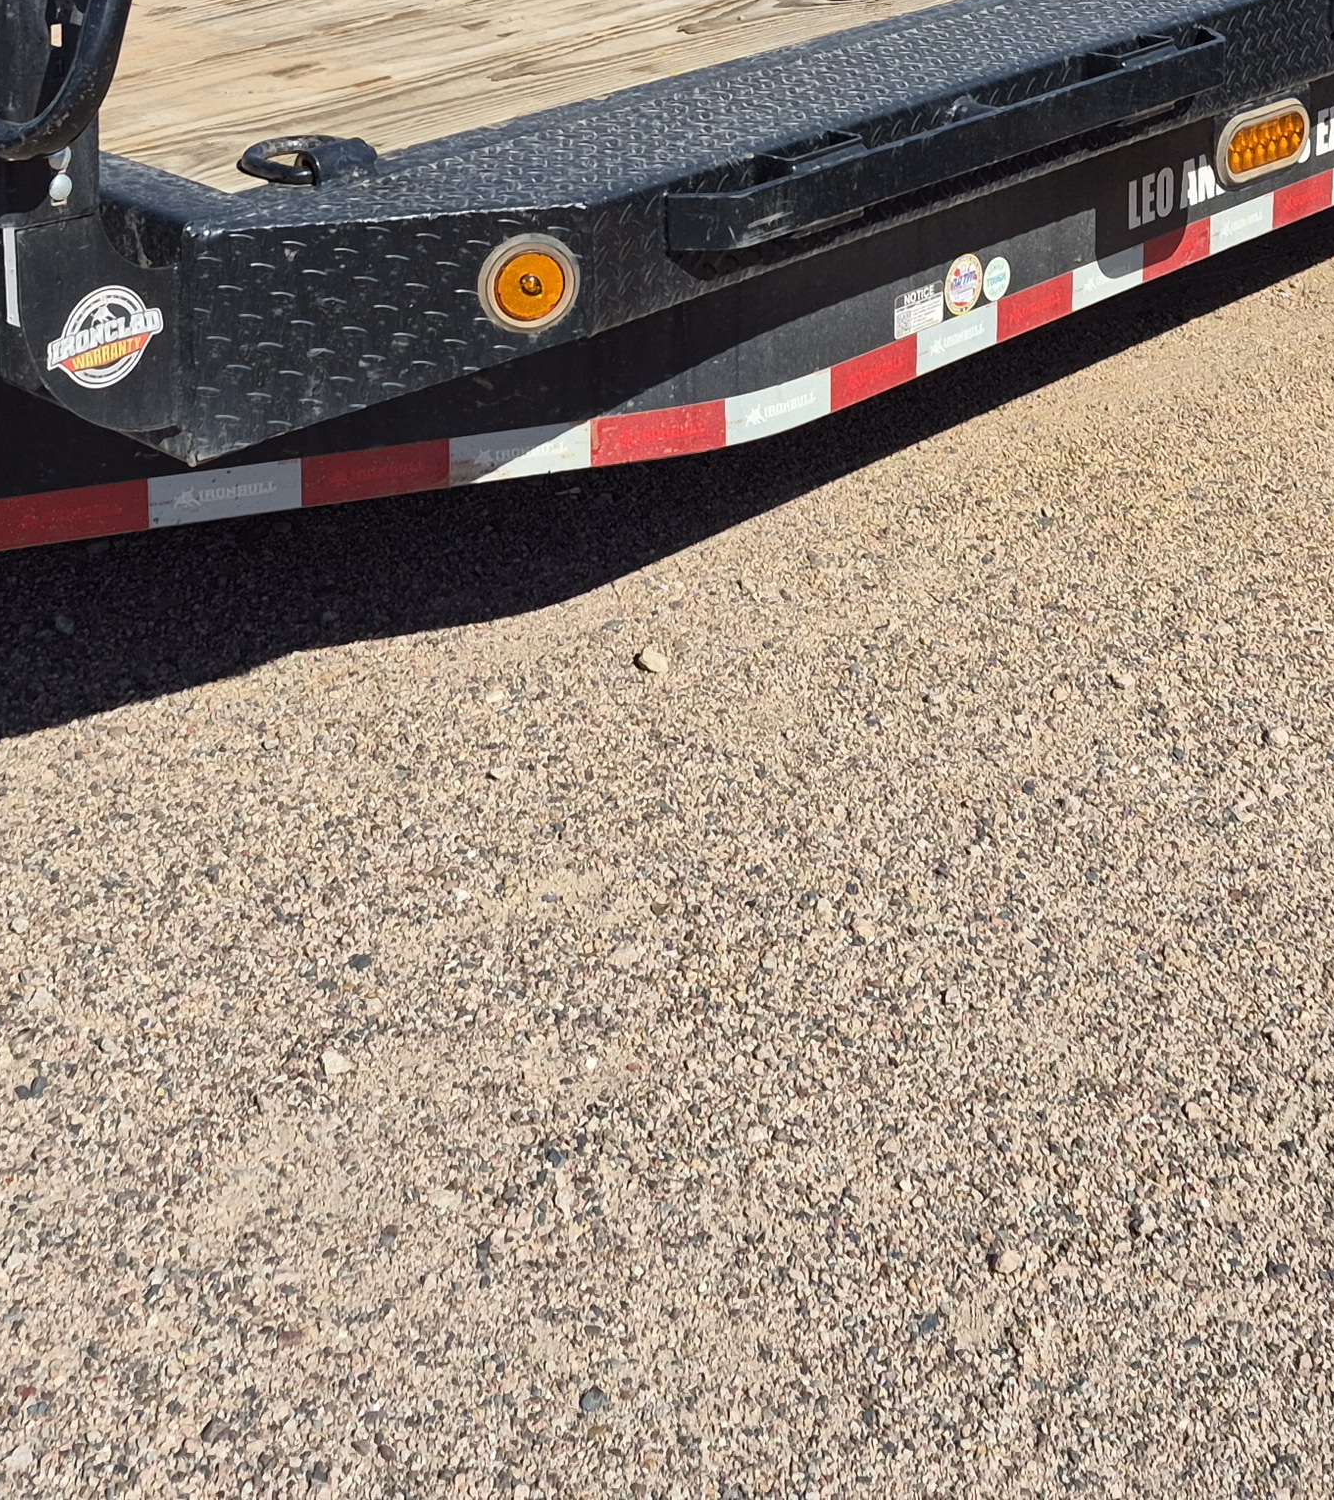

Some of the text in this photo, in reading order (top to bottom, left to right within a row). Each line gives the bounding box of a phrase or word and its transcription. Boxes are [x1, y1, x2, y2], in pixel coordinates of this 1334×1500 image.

[1128, 166, 1174, 231] LEO
[903, 285, 935, 306] NOTICE
[50, 311, 161, 366] IRONCLAD
[943, 321, 986, 349] IRONBULL
[72, 336, 143, 370] WARRANTY
[763, 392, 817, 419] IRONBULL
[496, 441, 569, 465] IRONBULL
[198, 480, 278, 503] IRONBULL
